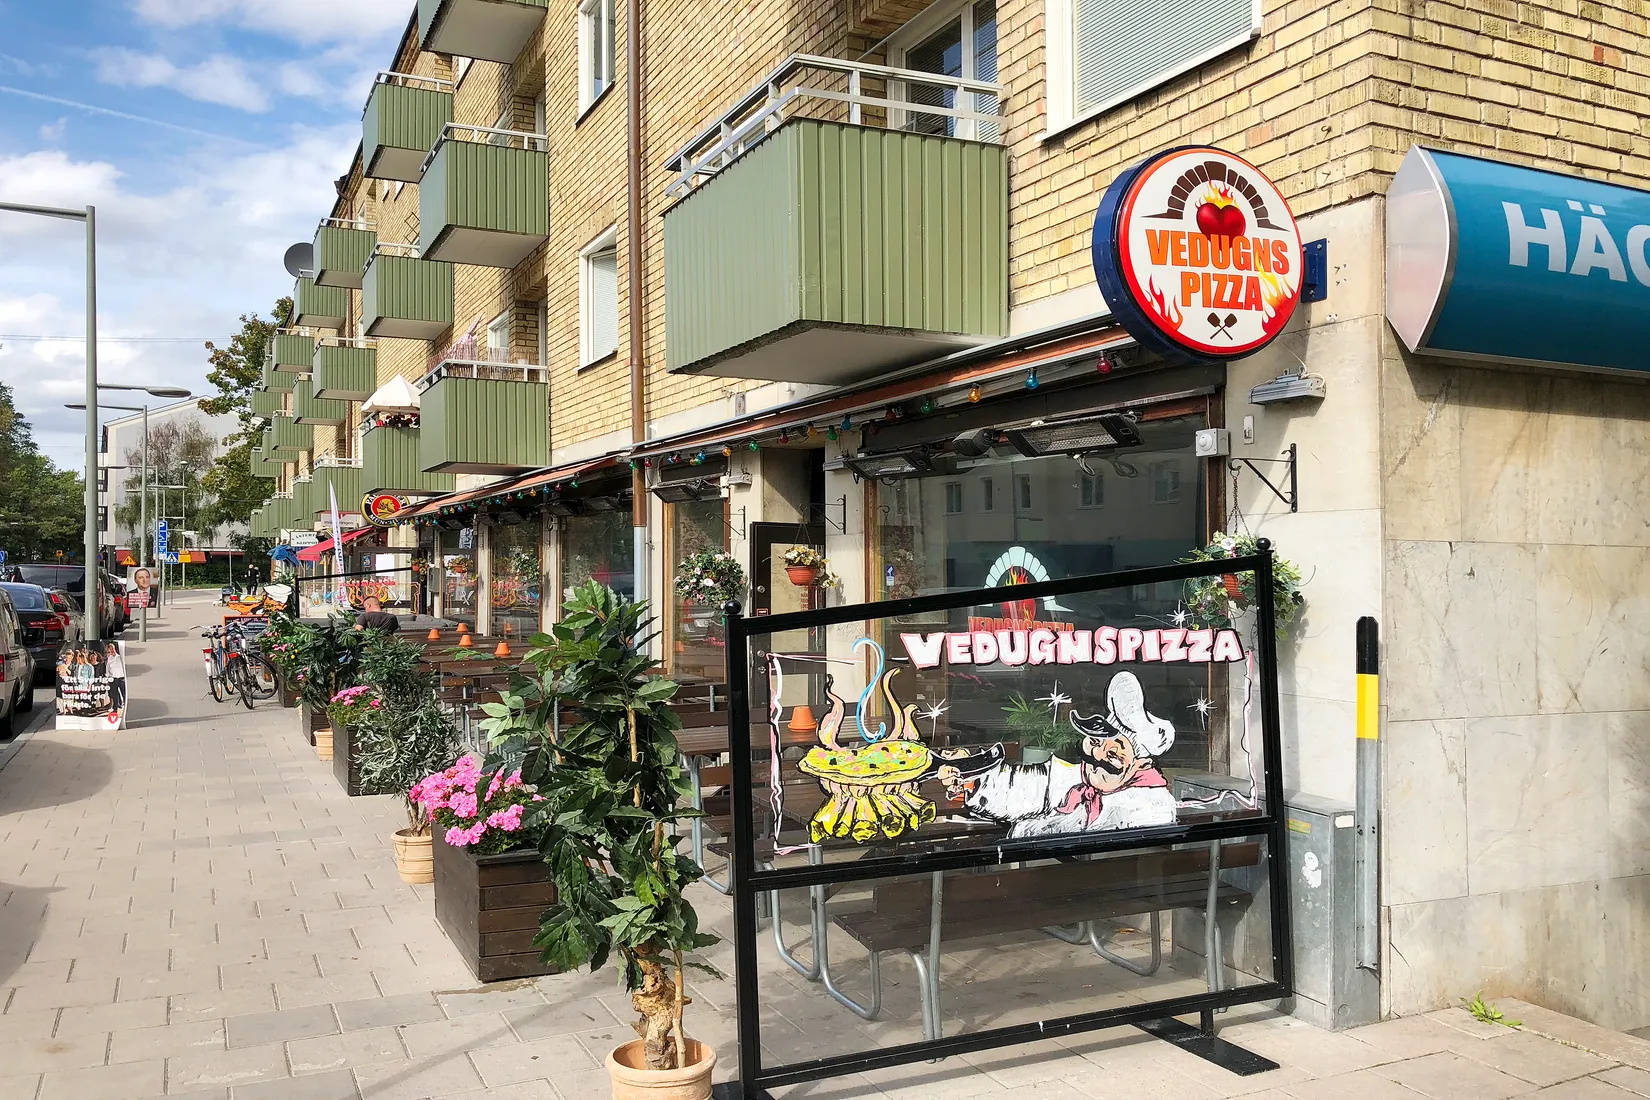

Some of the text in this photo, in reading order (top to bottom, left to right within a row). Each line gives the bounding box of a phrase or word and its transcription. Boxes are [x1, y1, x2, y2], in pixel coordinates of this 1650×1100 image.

[1145, 229, 1290, 275] VEDUGNS
[1181, 271, 1263, 311] PIZZA
[900, 625, 1245, 669] VEDUGNSPIZZA
